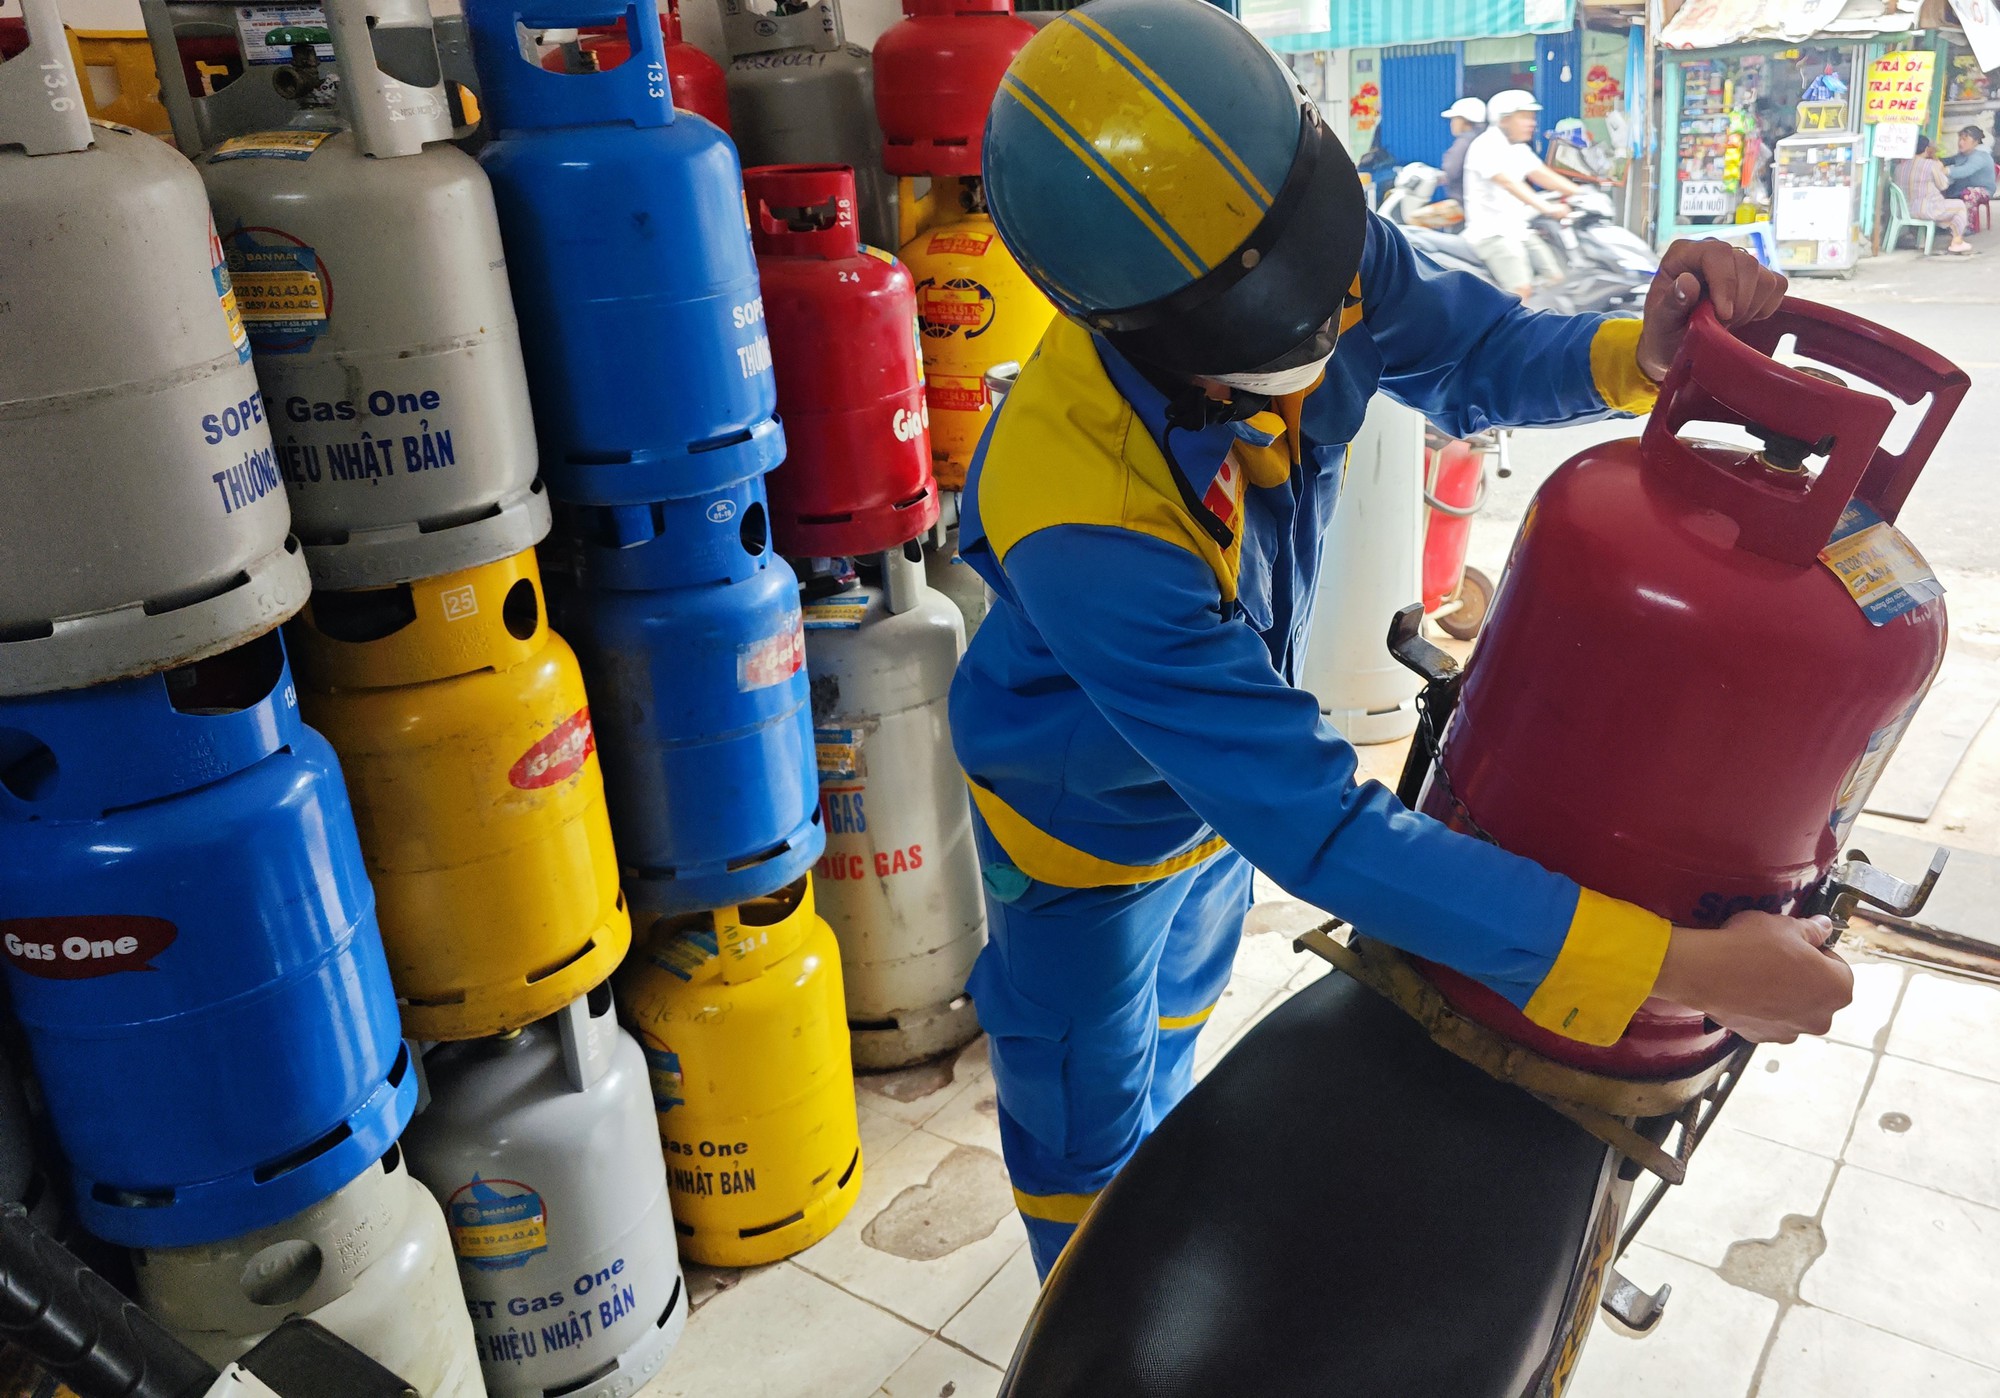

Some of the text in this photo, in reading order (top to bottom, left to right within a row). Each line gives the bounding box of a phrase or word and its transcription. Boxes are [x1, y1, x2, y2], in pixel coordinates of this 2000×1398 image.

[40, 58, 75, 112] 13.6
[647, 61, 665, 98] 13.3
[838, 199, 852, 228] 12.8
[285, 396, 356, 423] Gas
[368, 390, 440, 417] One
[327, 432, 394, 486] NHẬT
[402, 419, 455, 473] BẢN
[447, 592, 474, 614] 25
[873, 844, 923, 878] GAS
[4, 932, 138, 961] Gas One
[699, 1141, 749, 1157] One
[674, 1165, 714, 1199] NHẬT
[720, 1160, 756, 1195] BẢN
[507, 1290, 564, 1316] Gas
[573, 1258, 625, 1296] One
[488, 1324, 537, 1365] HIỆU
[541, 1310, 592, 1354] NHẬT
[598, 1283, 636, 1329] BẢN
